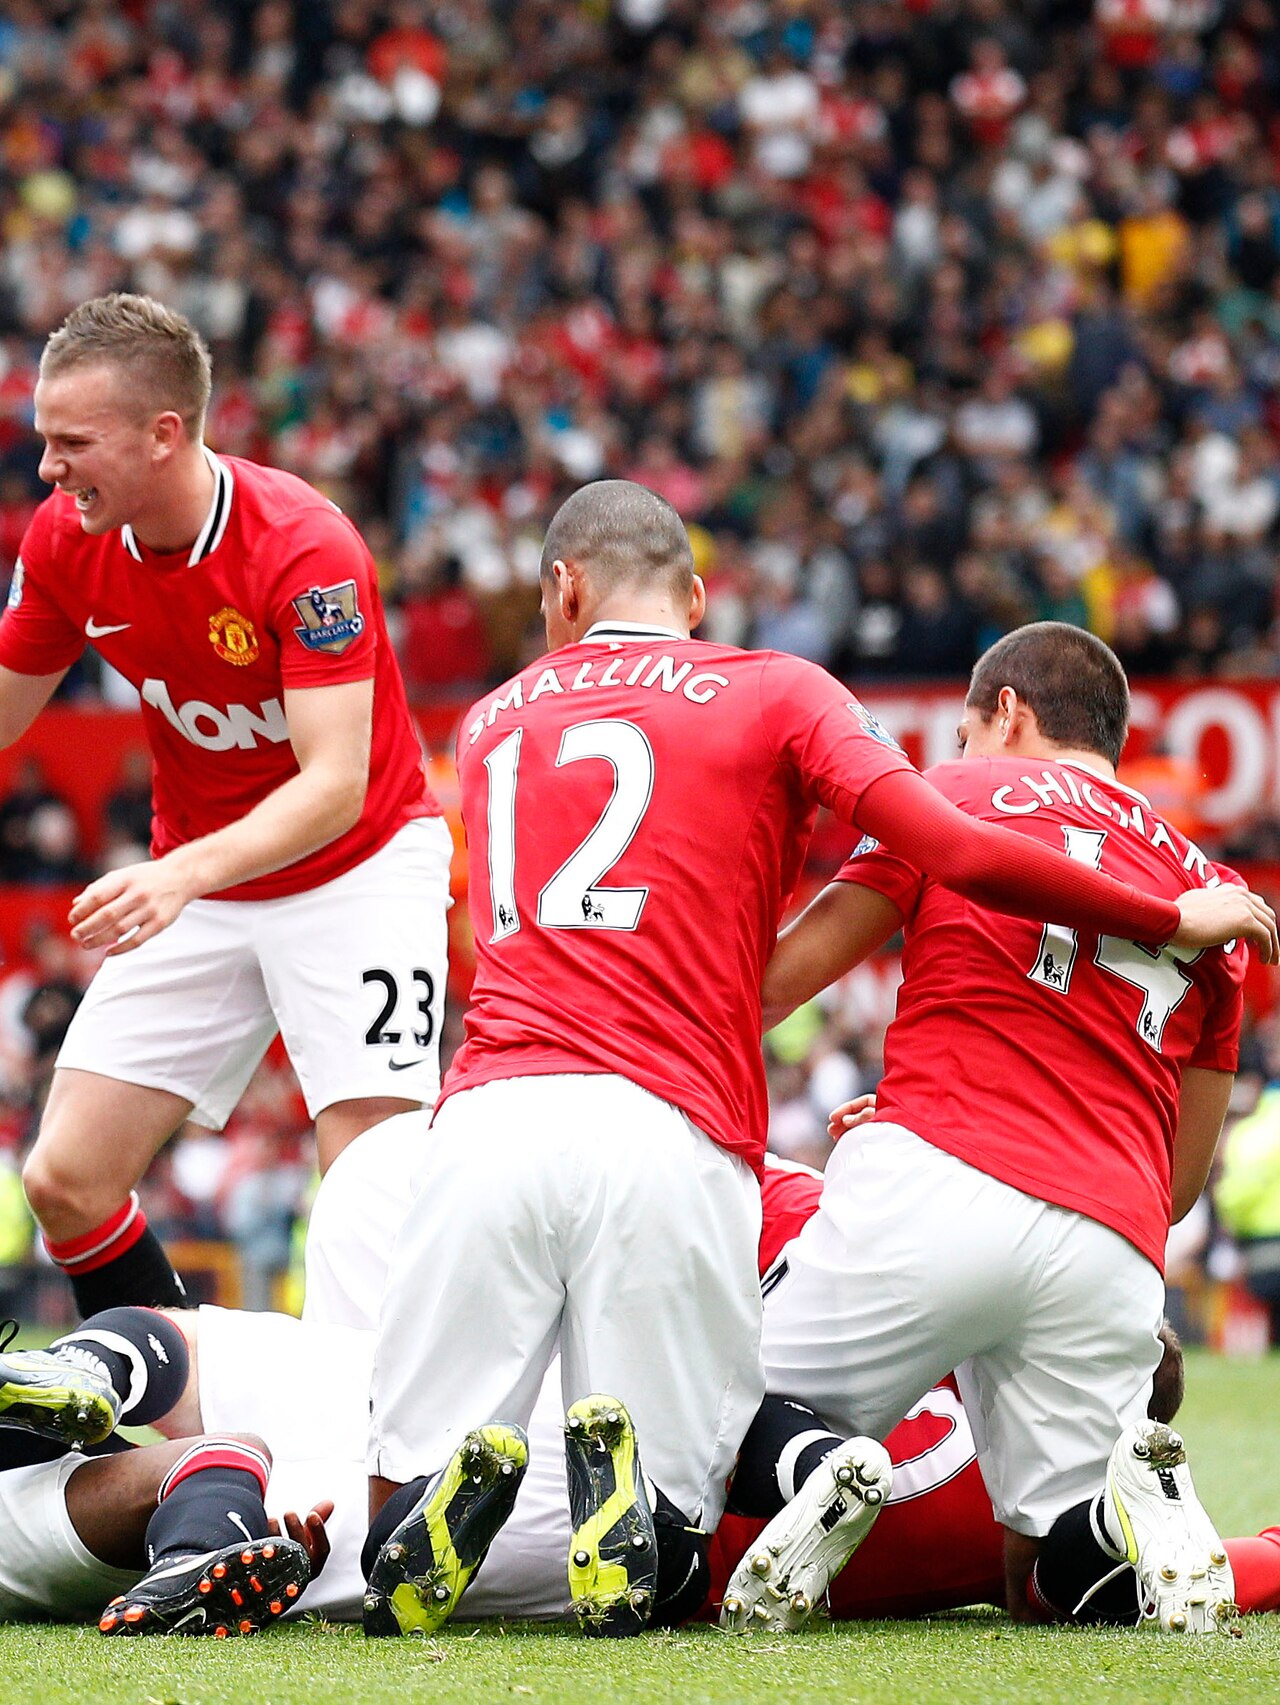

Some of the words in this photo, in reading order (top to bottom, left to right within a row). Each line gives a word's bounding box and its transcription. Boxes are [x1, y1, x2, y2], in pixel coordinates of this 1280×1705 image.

[309, 623, 351, 641] BARCLAYS
[469, 655, 730, 745] SMALLING
[483, 717, 655, 945] 12
[361, 966, 434, 1049] 23
[819, 1496, 848, 1533] NIKE
